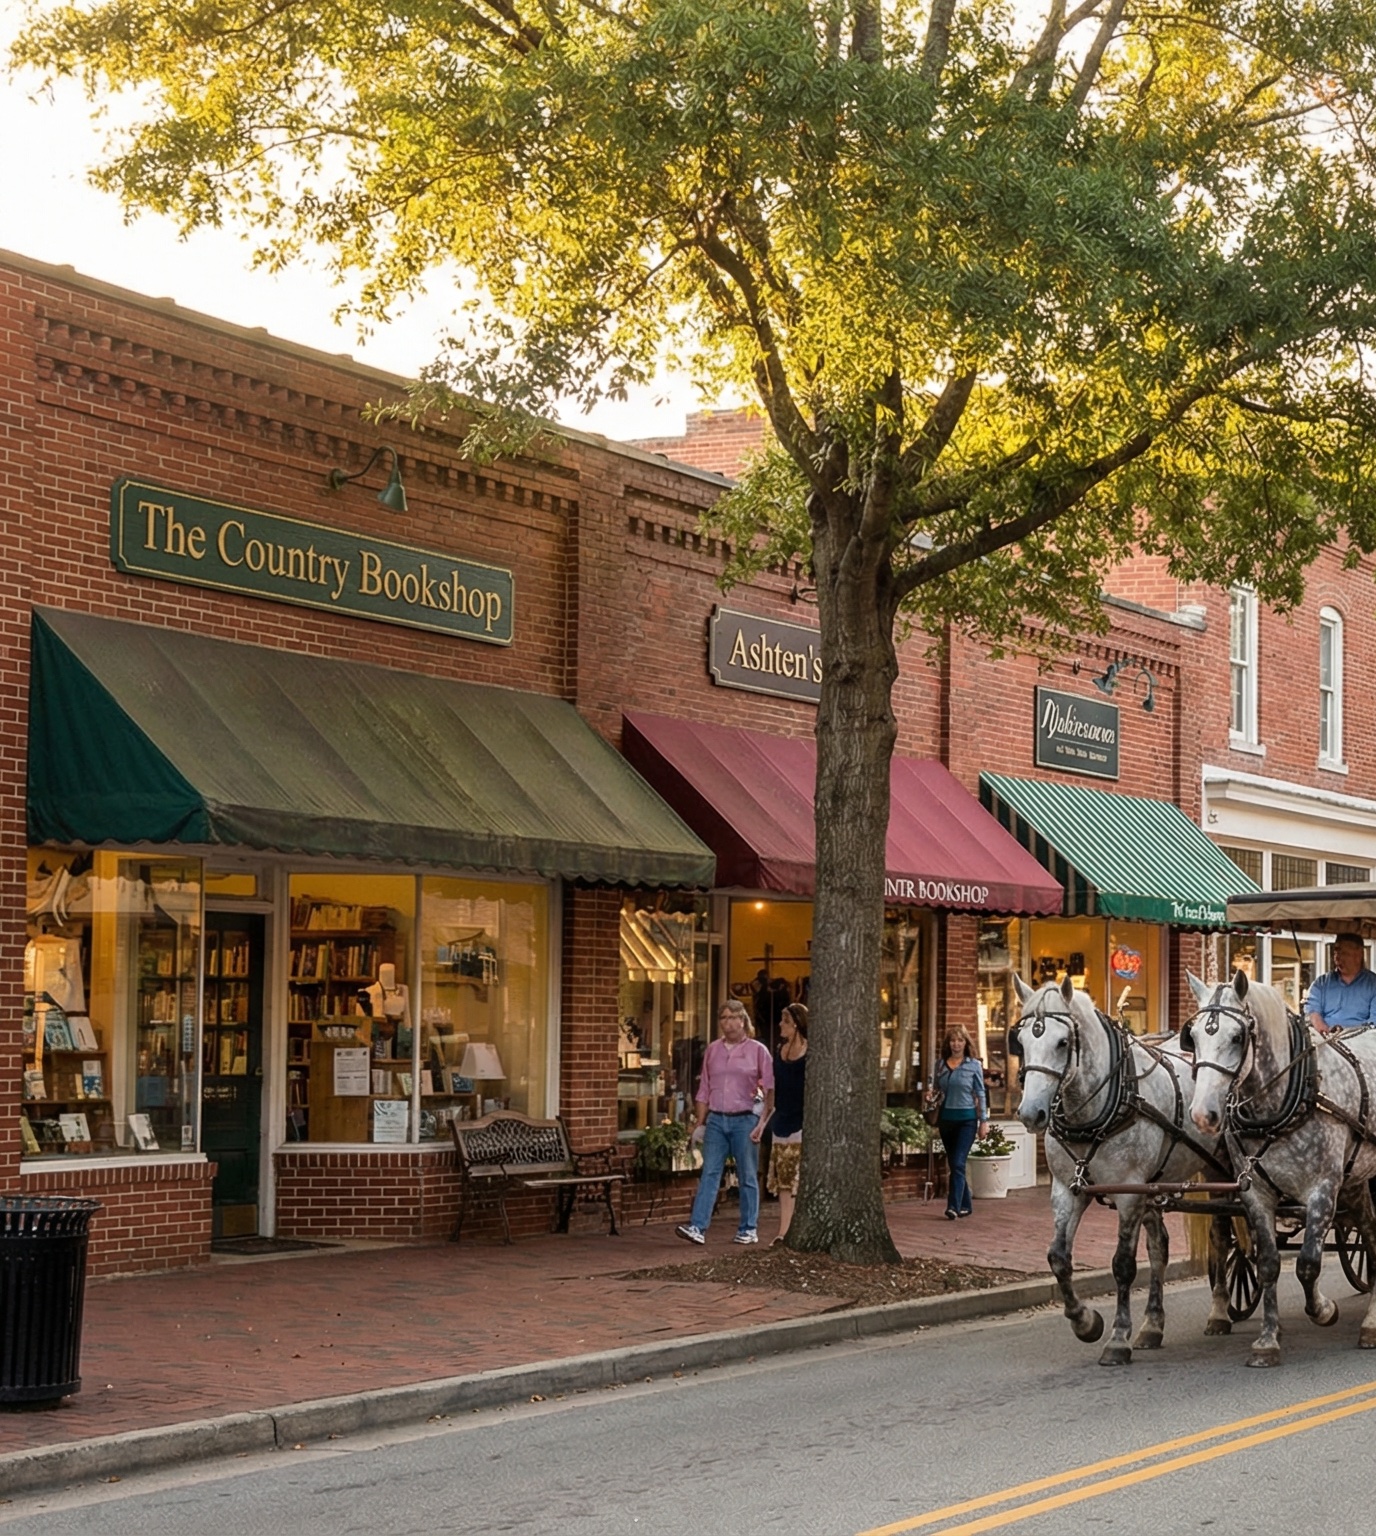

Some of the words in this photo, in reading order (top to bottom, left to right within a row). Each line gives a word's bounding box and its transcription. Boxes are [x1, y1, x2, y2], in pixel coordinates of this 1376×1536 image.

[138, 500, 206, 560] The
[216, 520, 350, 600] Country
[358, 549, 502, 632] Bookshop
[728, 628, 823, 684] Ashten's
[918, 879, 989, 904] BOOKSHOP
